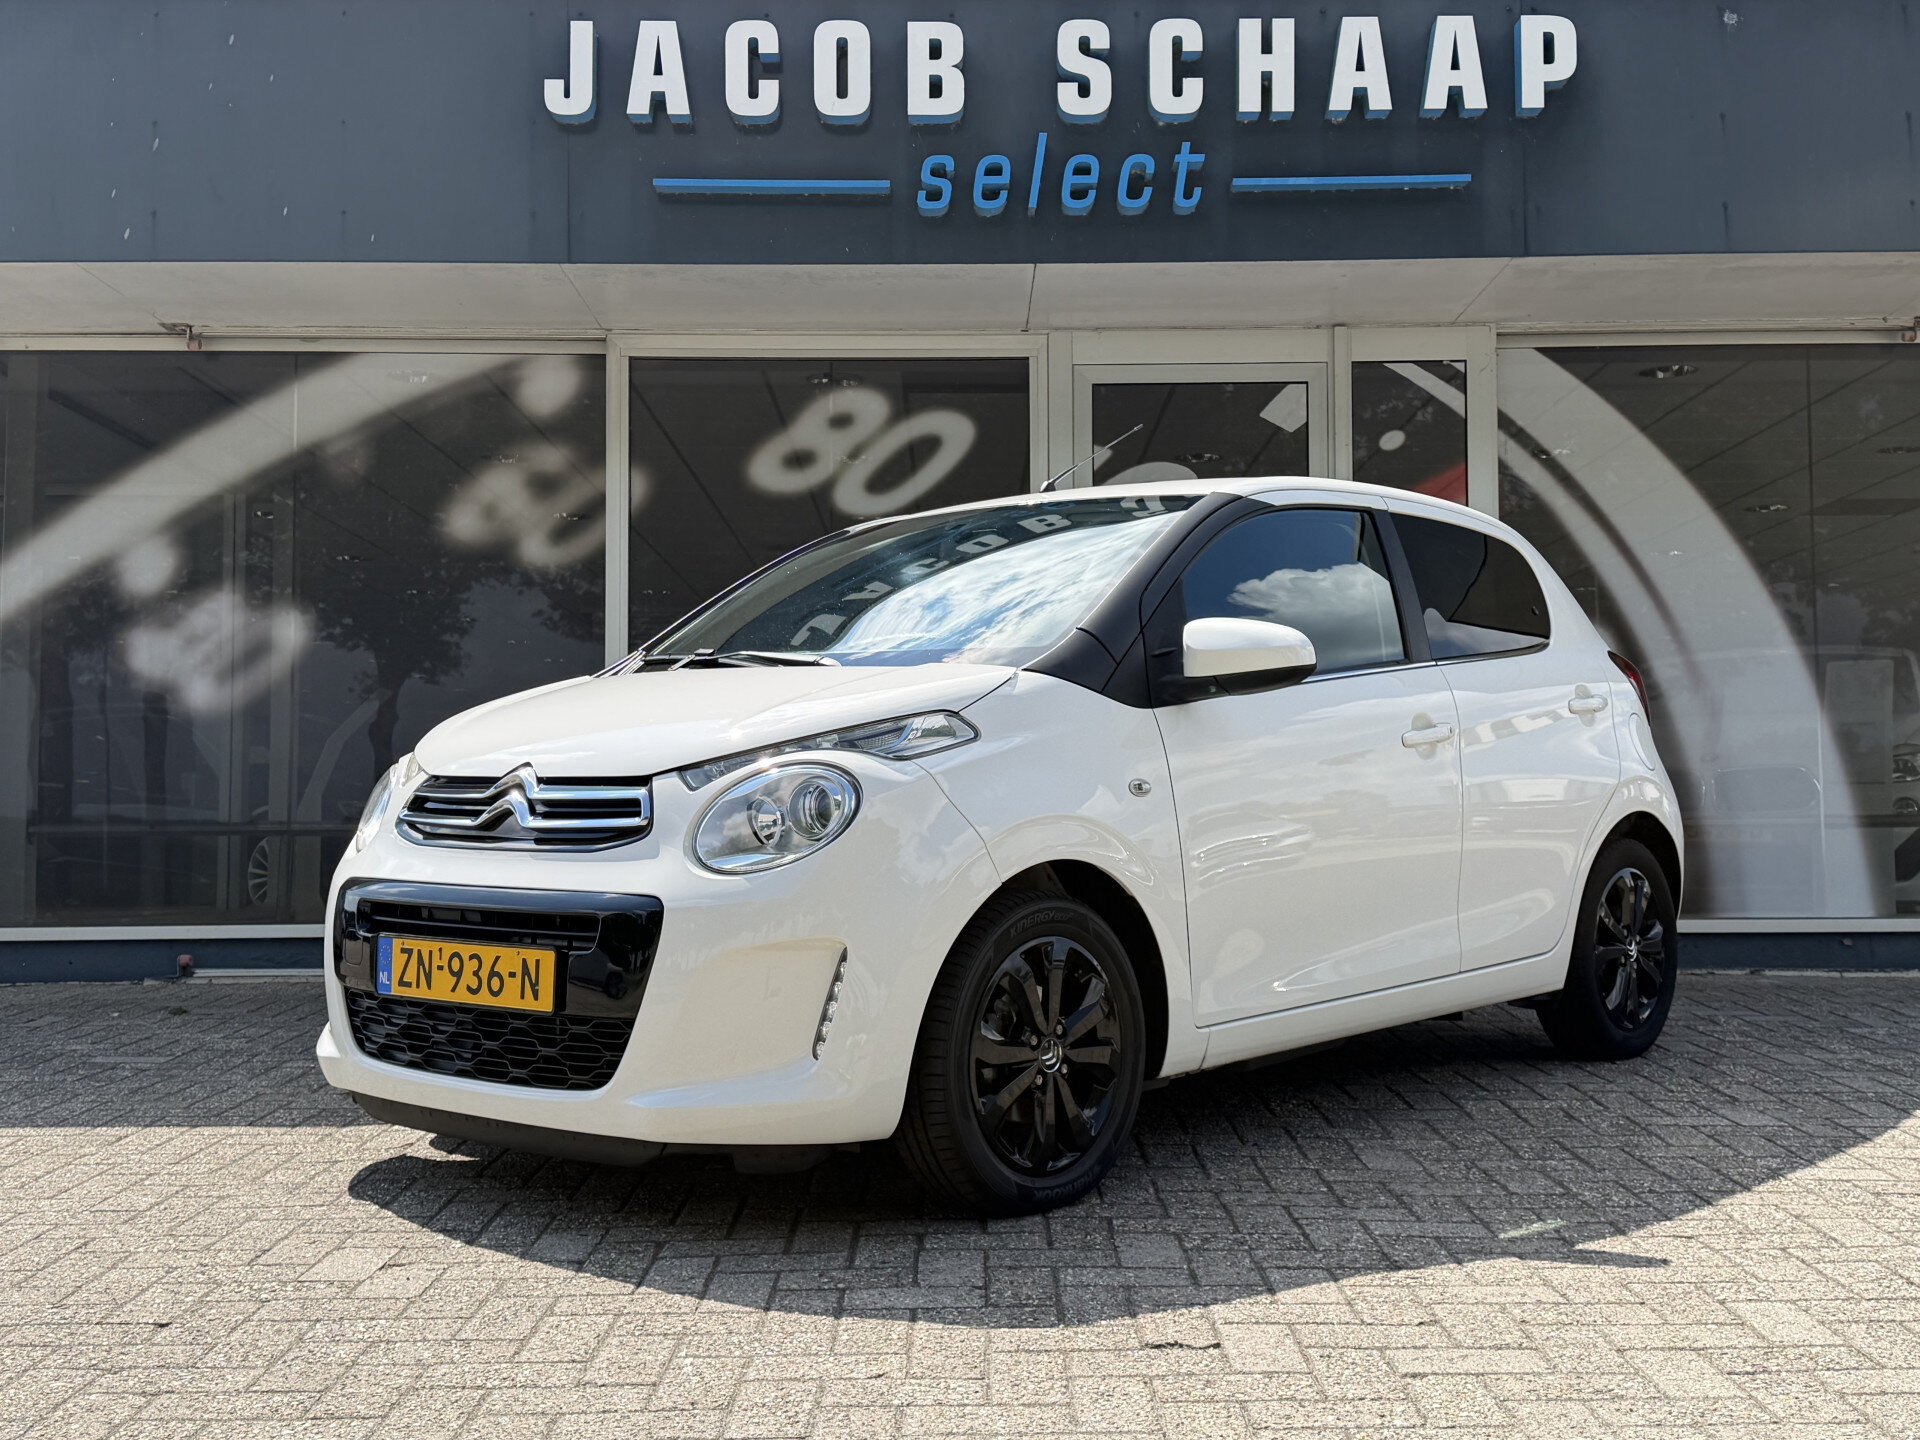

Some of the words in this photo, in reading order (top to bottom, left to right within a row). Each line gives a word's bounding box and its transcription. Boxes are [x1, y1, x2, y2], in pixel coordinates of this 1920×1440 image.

[544, 19, 967, 122] JACOB
[1057, 15, 1577, 122] SCHAAP
[917, 132, 1205, 215] select
[748, 387, 976, 518] 80
[379, 971, 390, 985] NL
[398, 946, 541, 1001] ZN-936-N
